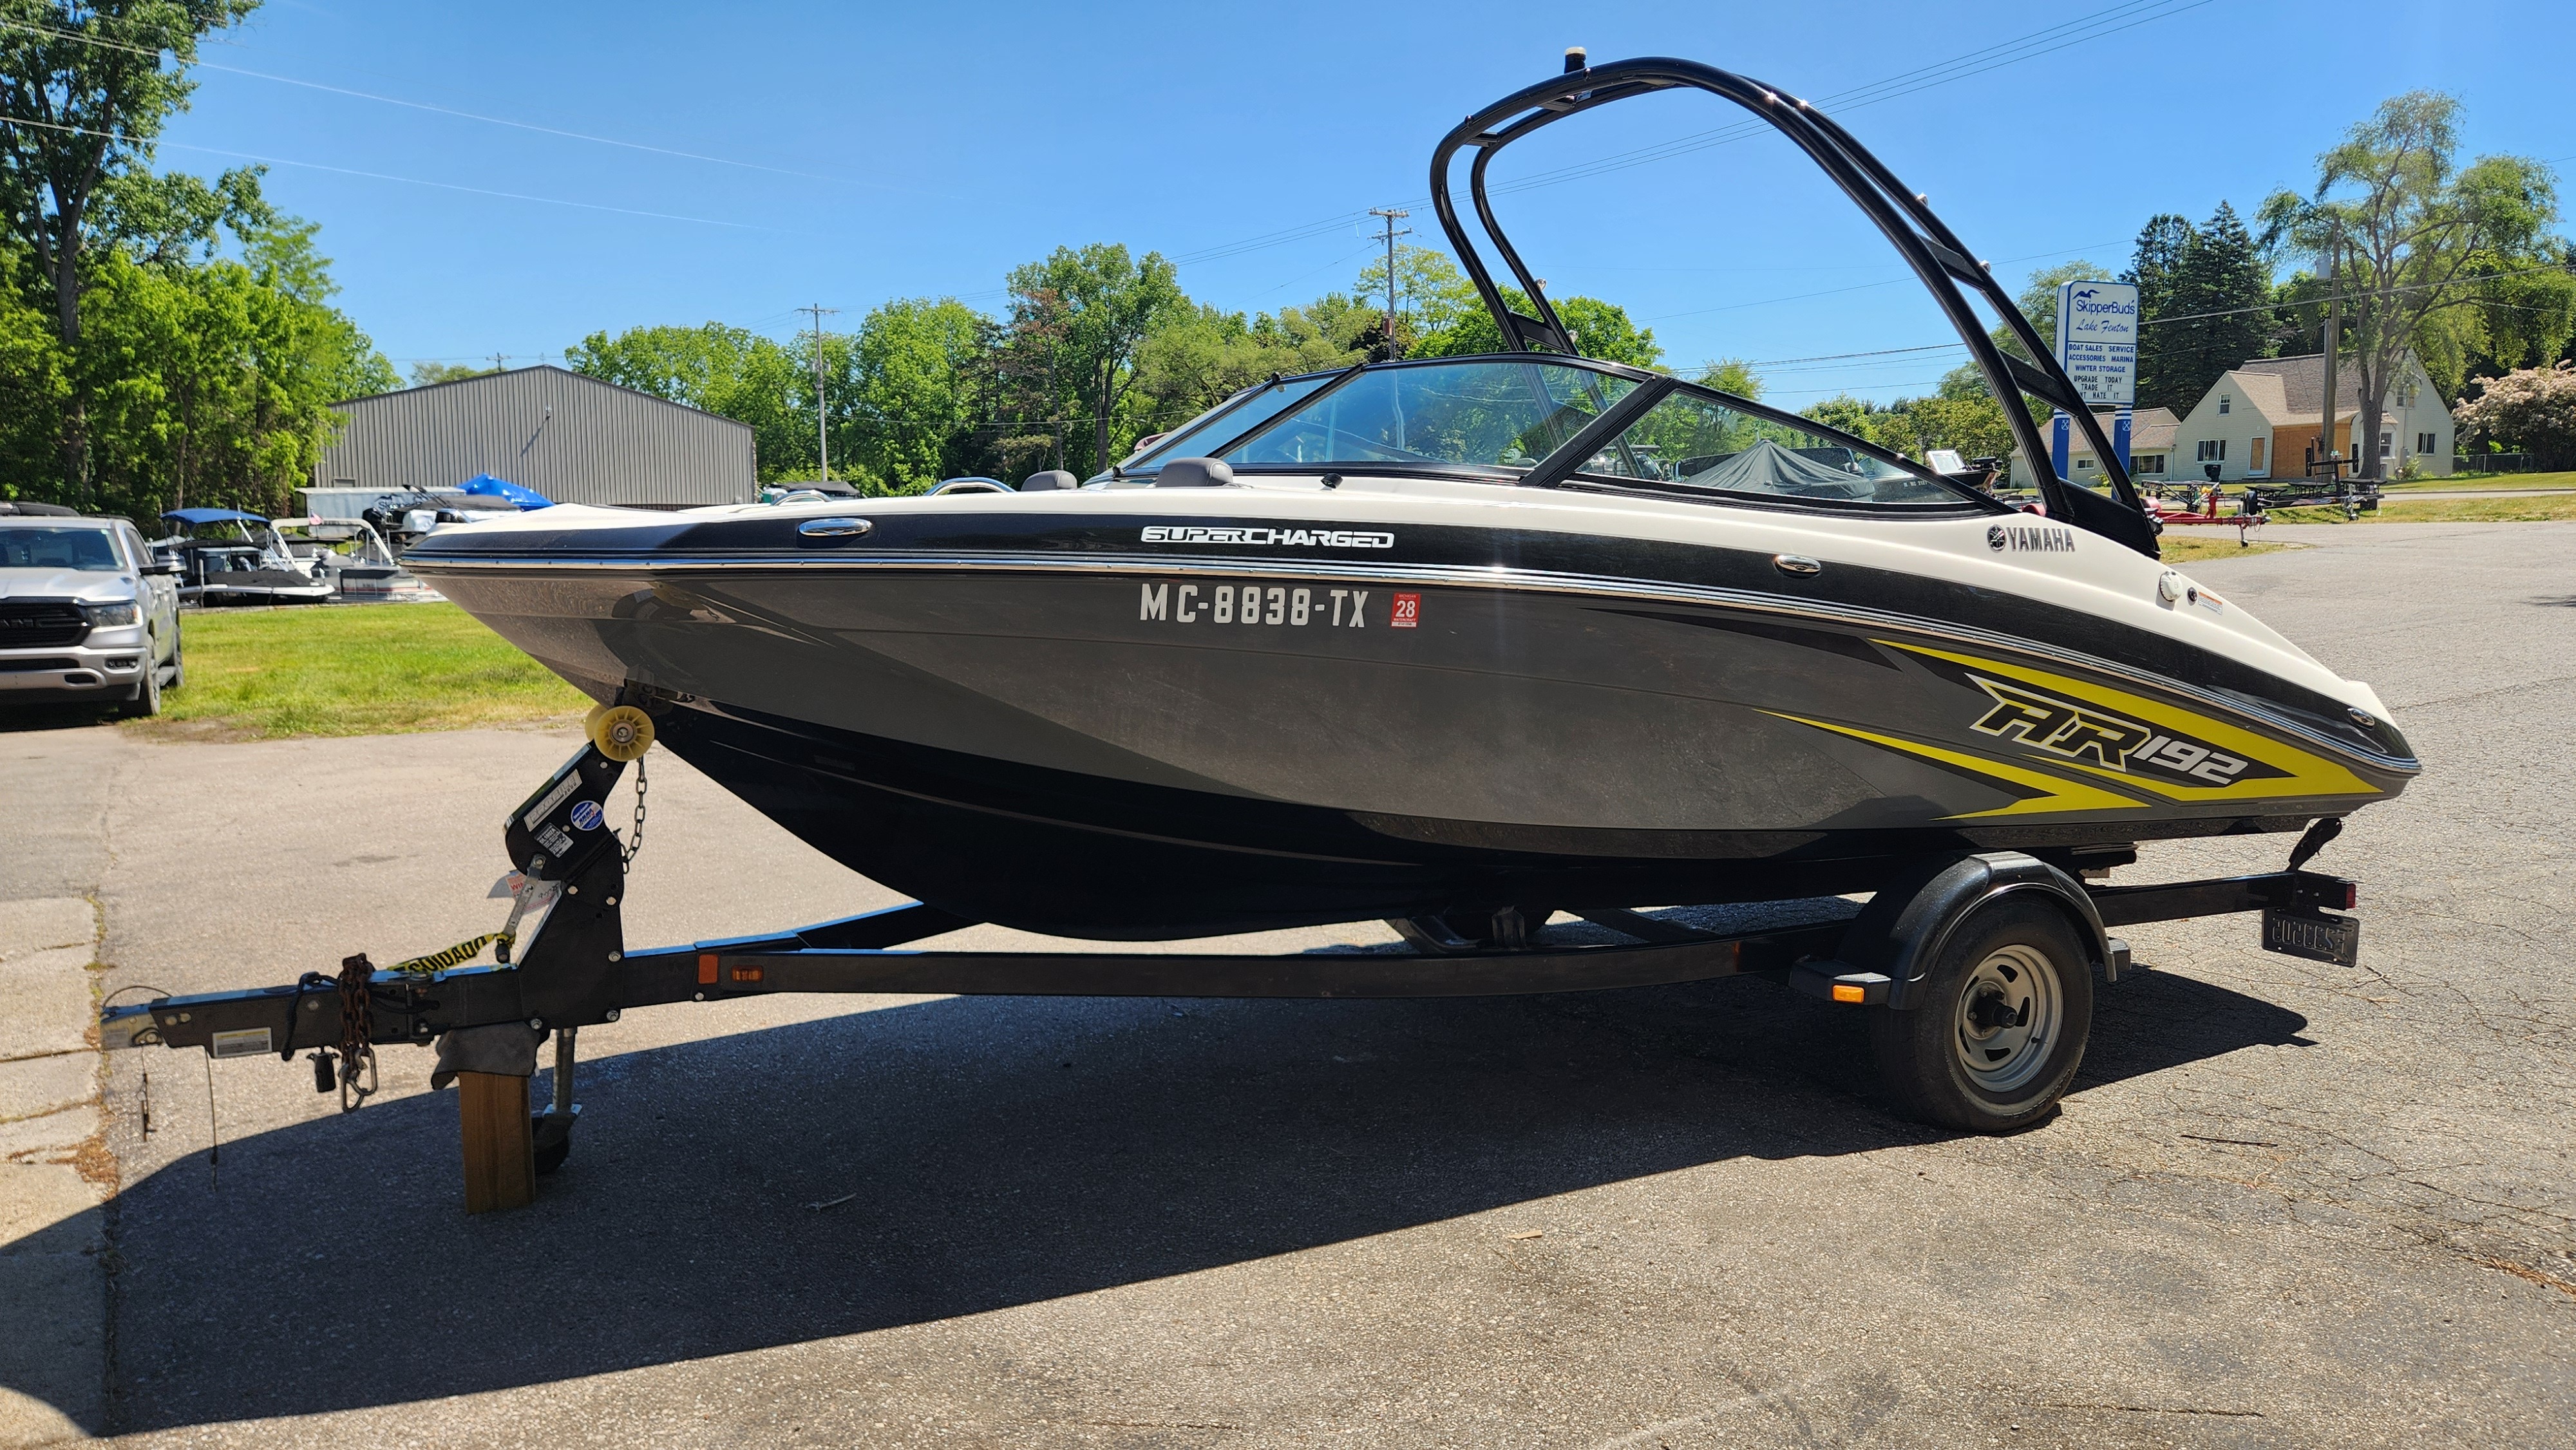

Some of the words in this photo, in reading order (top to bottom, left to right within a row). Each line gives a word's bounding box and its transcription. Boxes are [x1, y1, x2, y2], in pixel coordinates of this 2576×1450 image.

[2076, 299, 2135, 315] SkipperBud's
[2076, 319, 2098, 331] Lake
[2101, 320, 2128, 334] Fenton
[1141, 525, 1395, 549] SUPERCHARGED
[2005, 527, 2076, 552] YAMAHA
[1140, 583, 1369, 628] MC-8838-TX
[1395, 600, 1416, 617] 28
